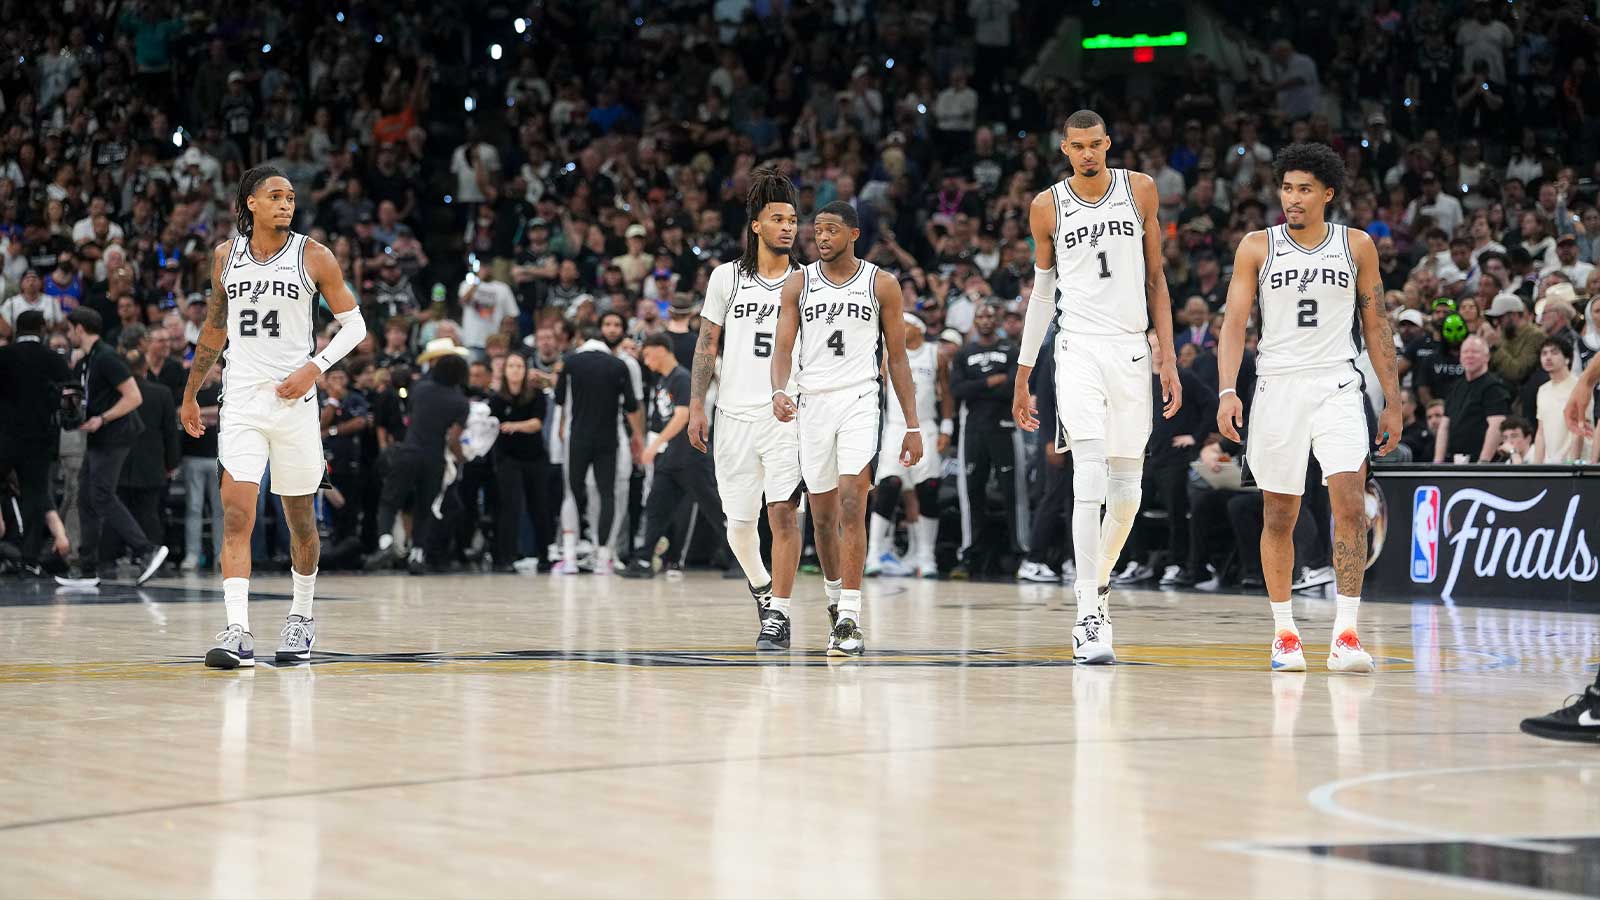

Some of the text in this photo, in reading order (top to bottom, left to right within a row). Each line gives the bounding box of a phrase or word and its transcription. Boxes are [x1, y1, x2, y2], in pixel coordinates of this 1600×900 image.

[1064, 221, 1134, 249] SPURS
[1097, 251, 1112, 279] 1
[227, 280, 300, 304] SPURS
[1271, 268, 1350, 294] SPURS
[239, 309, 280, 337] 24
[734, 302, 781, 325] SPU
[804, 302, 872, 325] SPURS
[1297, 299, 1318, 327] 2
[754, 332, 773, 358] 5
[827, 330, 845, 356] 4
[1441, 487, 1599, 597] Finals
